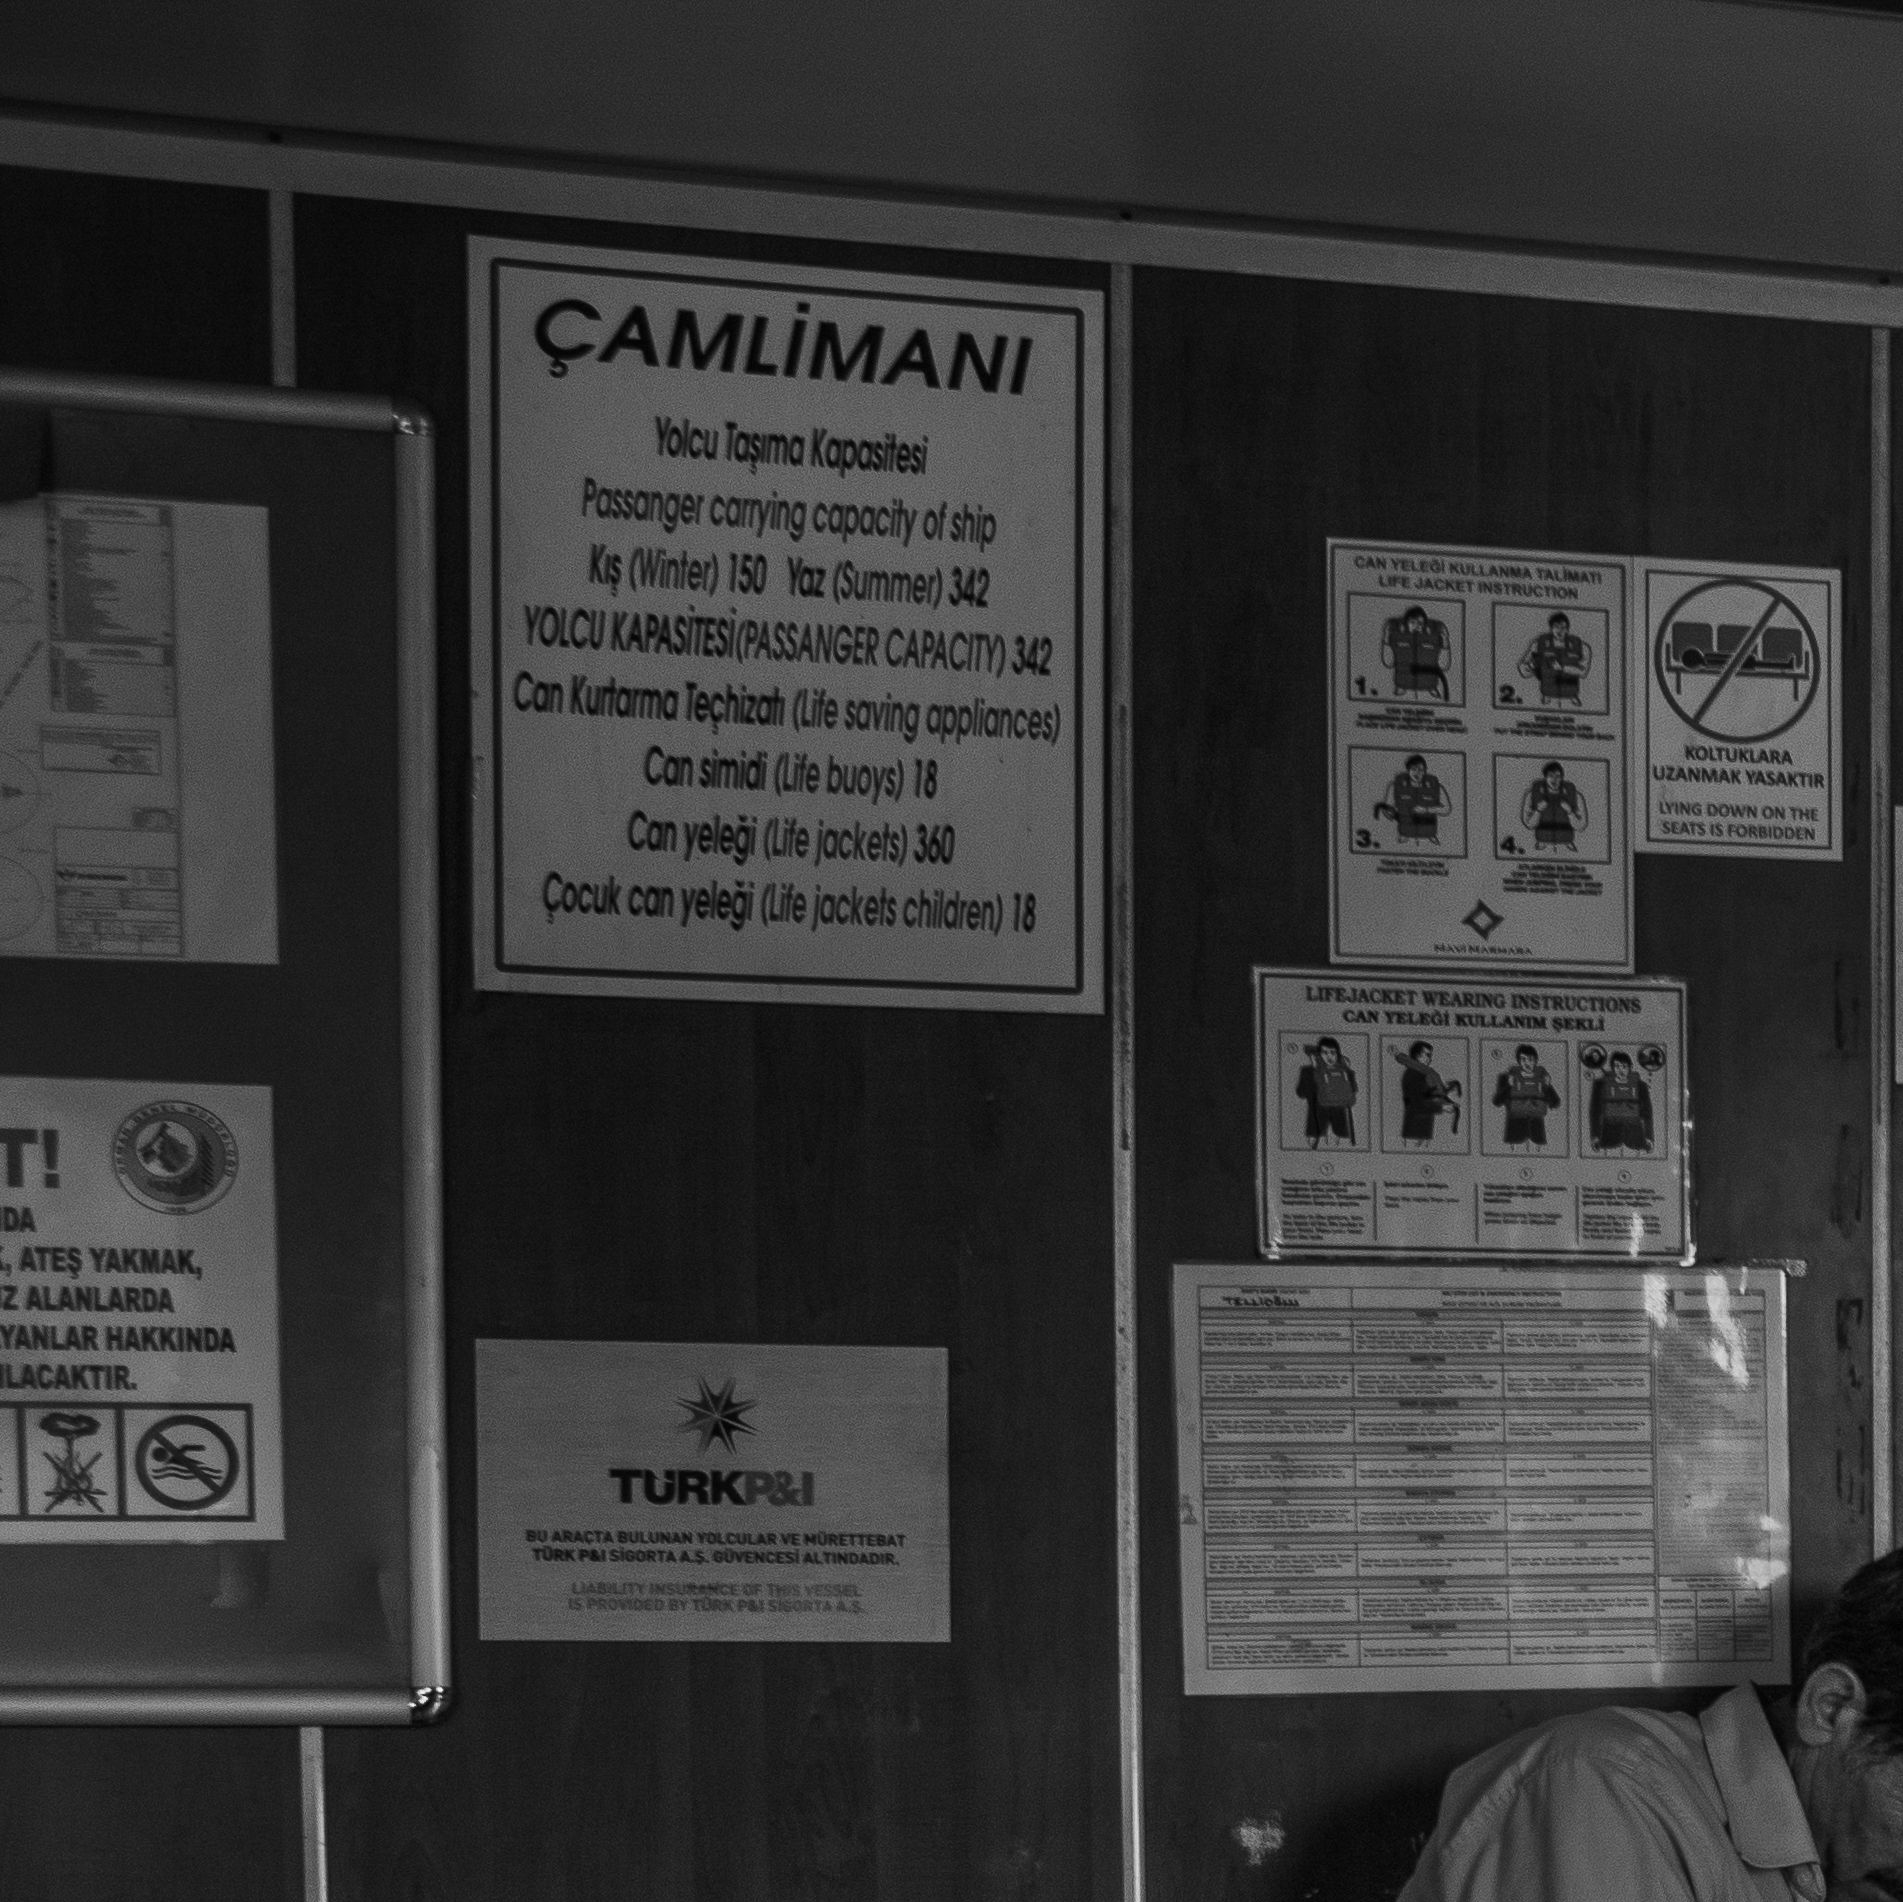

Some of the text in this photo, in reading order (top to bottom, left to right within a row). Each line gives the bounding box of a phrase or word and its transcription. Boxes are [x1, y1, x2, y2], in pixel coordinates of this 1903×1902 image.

[534, 299, 1033, 395] ÇAMLİMANI
[655, 417, 928, 478] Yolcu Taşıma Kapasitesi
[582, 477, 997, 550] Passanger carrying capacity of ship
[589, 544, 990, 609] Kış (Winter) 150 Yaz (Summer) 342
[1354, 556, 1602, 584] CAN YELEĞİ KULLANMA TALİMATI
[1376, 575, 1578, 599] LIFE JACKET INSTRUCTION
[524, 605, 605, 650] YOLCU
[885, 628, 1006, 677] CAPACITY)
[1012, 635, 1052, 676] 342
[513, 671, 1060, 745] Can Kurtarma Teçhizatı (Life saving appliances)
[1685, 743, 1793, 765] KOLTUKLARA
[644, 745, 938, 803] Can simidi (Life buoys) 18
[1653, 766, 1824, 788] UZANMAK YASAKTIR
[1659, 801, 1818, 825] LYING DOWN ON THE
[627, 810, 955, 866] Can yeleği (Life jackets) 360
[1658, 821, 1815, 842] SEATS IS FORBIDDEN
[542, 871, 1036, 936] Çocuk can yeleği (Life jackets children) 18
[1306, 986, 1641, 1013] LIFEJACKET WEARING INSTRUCTIONS
[1342, 1010, 1605, 1032] CAN YELEĞİ KULLANIM ŞEKLİ
[0, 1128, 59, 1188] T!
[0, 1206, 35, 1232] DA
[19, 1246, 82, 1279] ATEŞ
[89, 1248, 202, 1280] YAKMAK,
[25, 1286, 174, 1312] ALANLARDA
[106, 1326, 236, 1352] HAKKINDA
